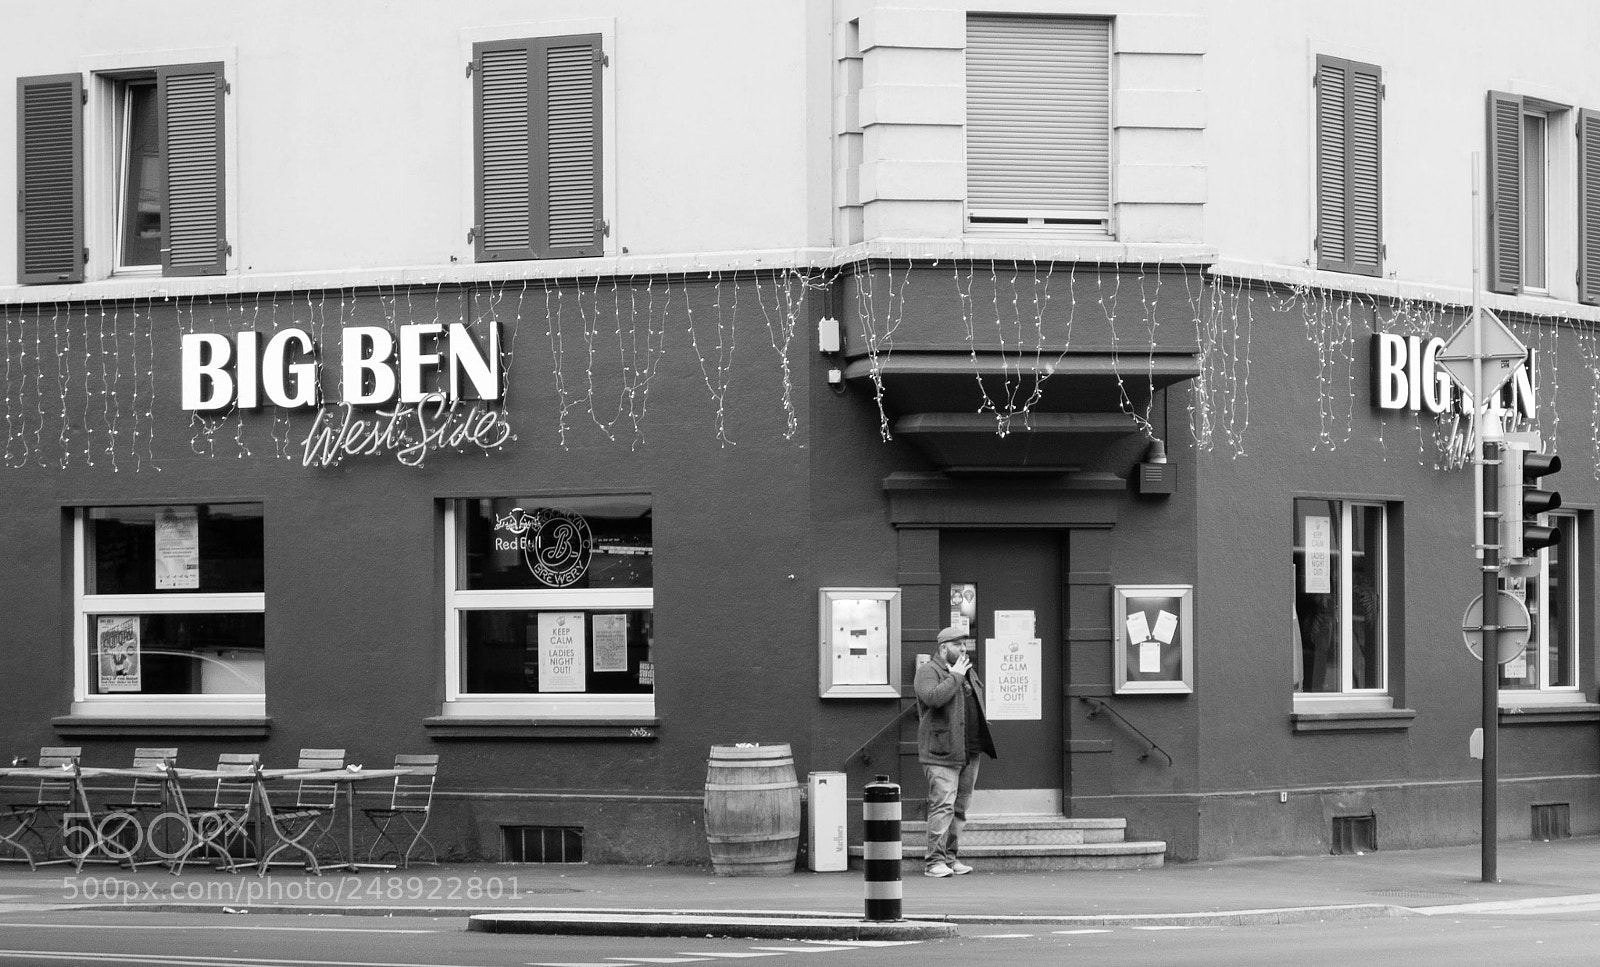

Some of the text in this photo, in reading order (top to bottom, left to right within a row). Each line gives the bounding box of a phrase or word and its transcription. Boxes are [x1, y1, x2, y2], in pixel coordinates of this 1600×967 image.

[182, 321, 498, 411] BIG BEN
[1380, 333, 1451, 413] BIG
[301, 392, 510, 466] West Side
[495, 537, 518, 551] Red
[533, 560, 584, 584] BREWERY
[550, 636, 573, 644] CALM
[549, 649, 574, 657] LADIES
[1003, 654, 1025, 662] KEEP
[553, 666, 571, 674] OUT!
[1000, 663, 1028, 671] CALM
[998, 676, 1029, 684] LADIES
[999, 685, 1028, 693] NIGHT
[1003, 693, 1024, 701] OUT!
